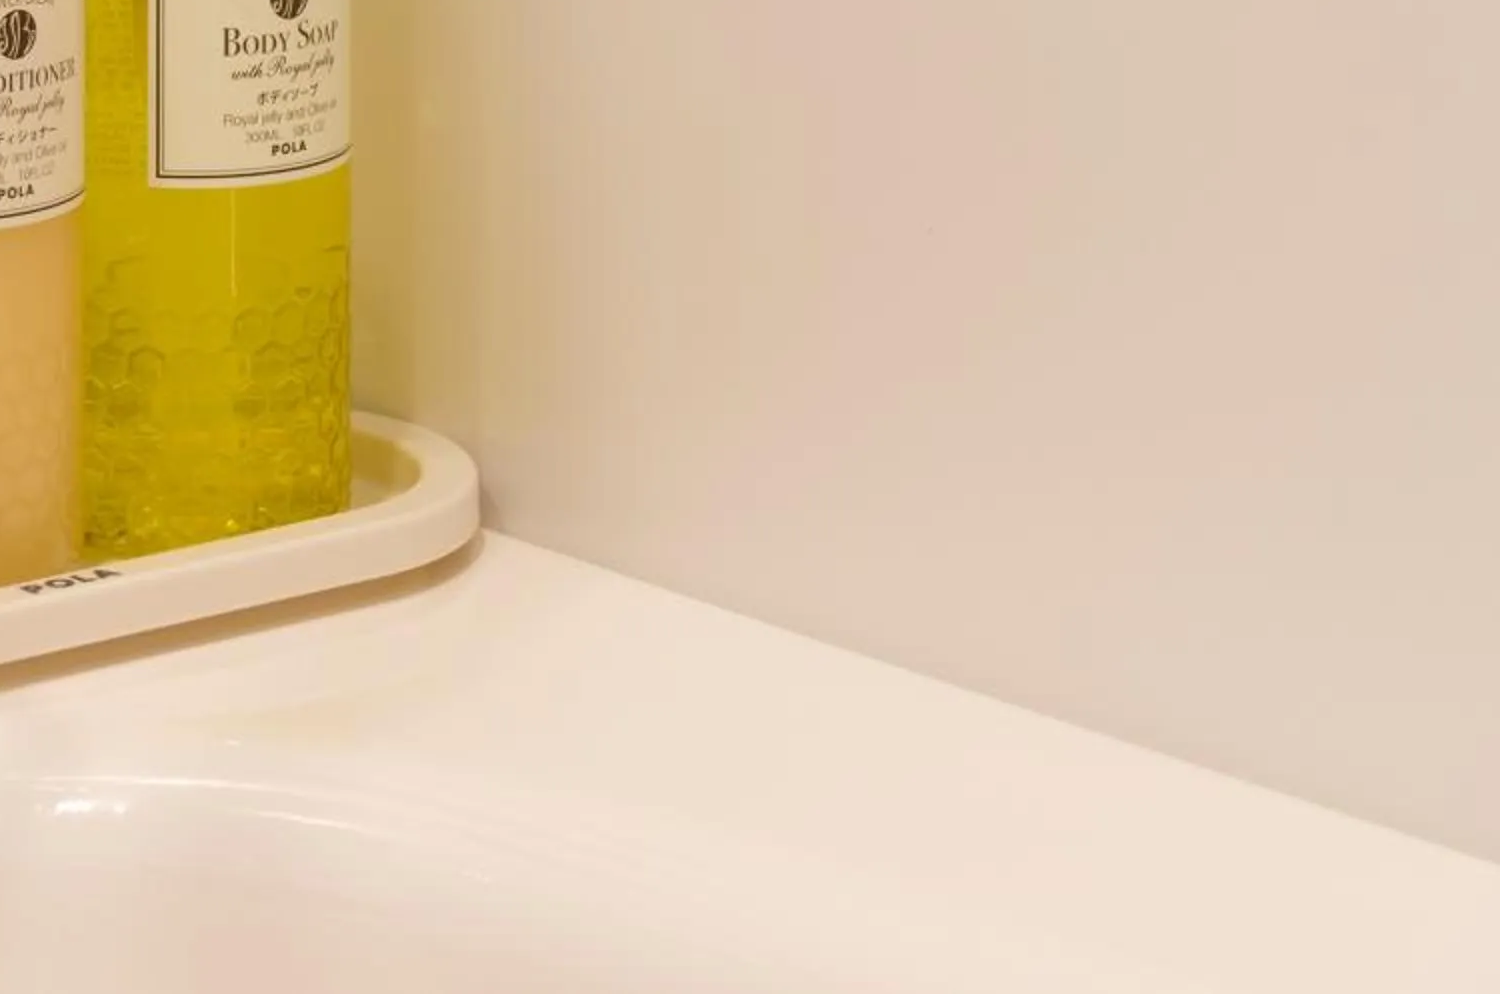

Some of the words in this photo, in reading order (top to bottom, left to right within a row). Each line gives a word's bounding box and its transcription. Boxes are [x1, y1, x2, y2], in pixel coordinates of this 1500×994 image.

[223, 27, 291, 57] BODY
[296, 19, 339, 49] SOAP
[231, 61, 263, 80] with
[266, 53, 315, 82] Royal
[257, 82, 319, 106] ボディソープ
[271, 140, 307, 156] POLA
[20, 569, 122, 595] POLA
